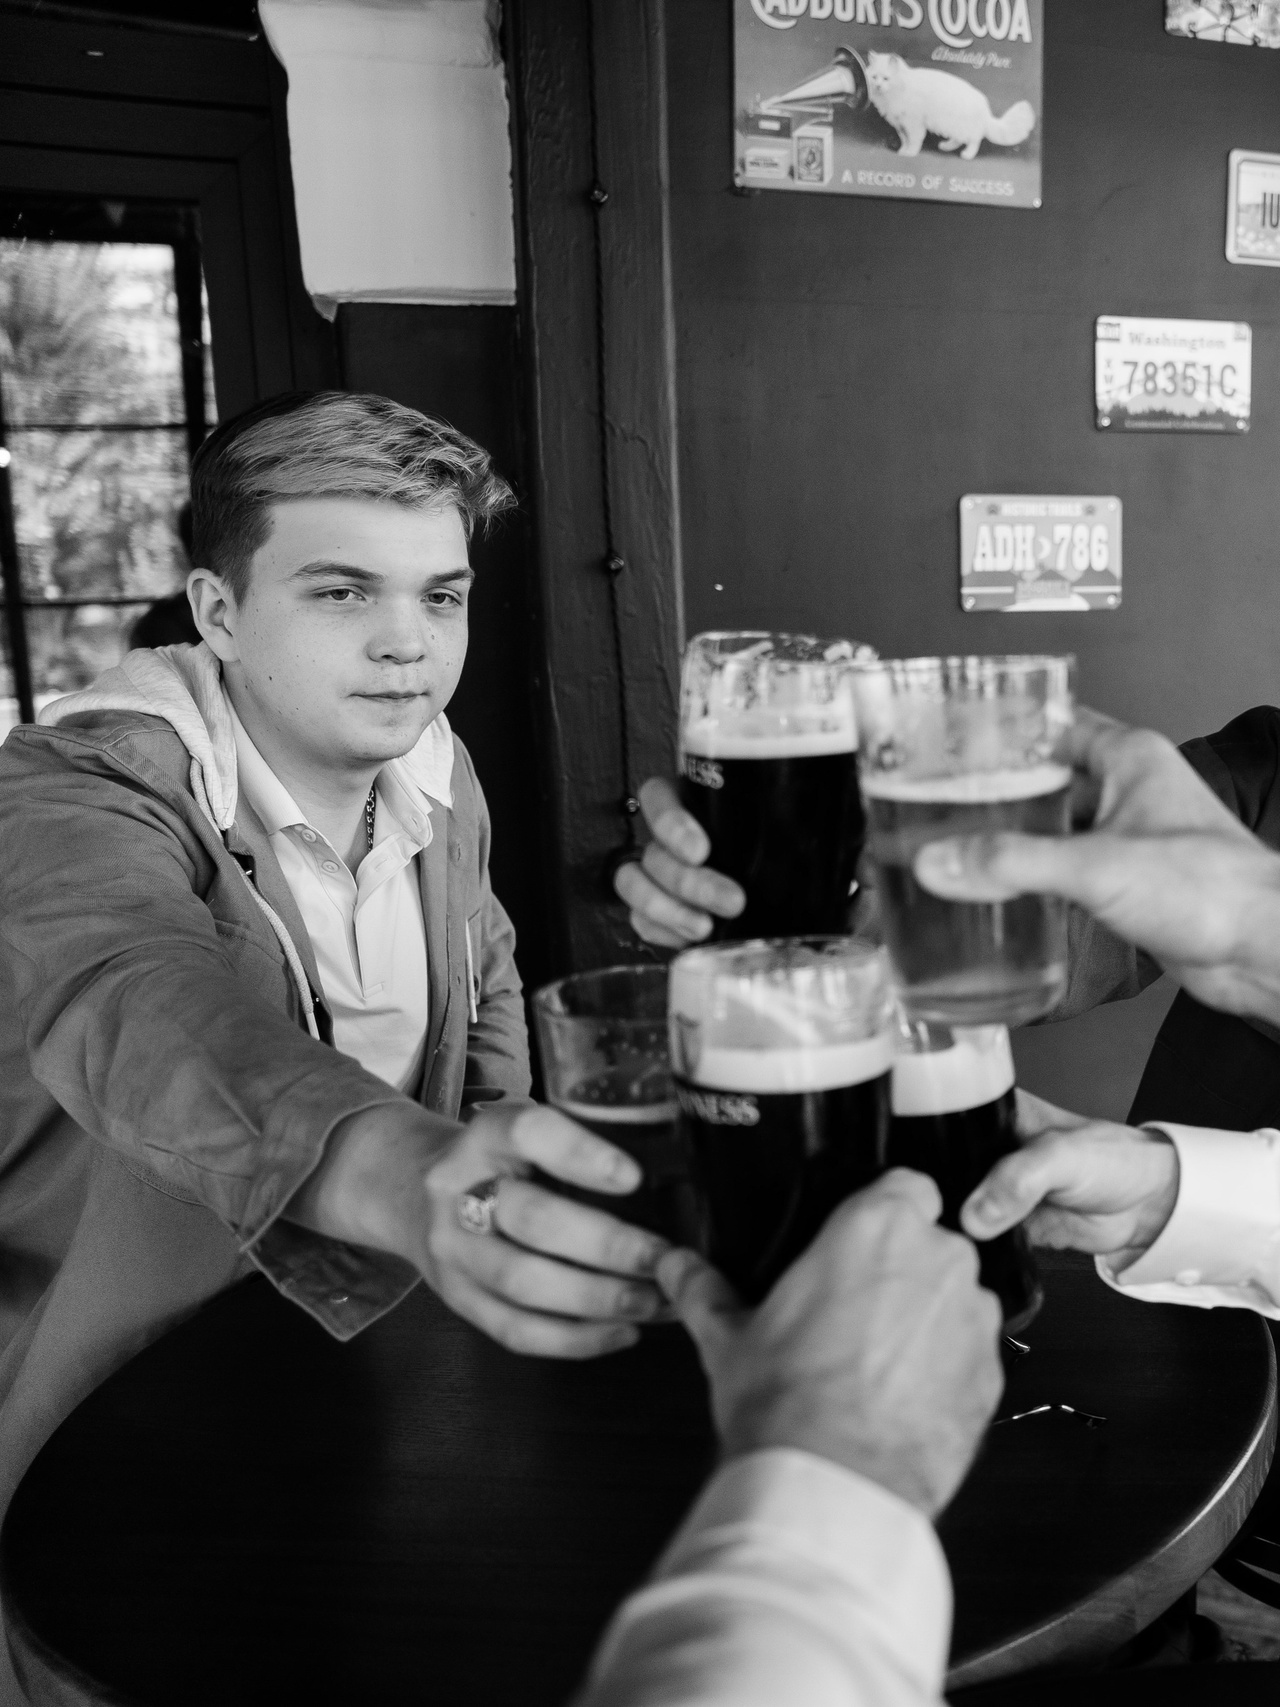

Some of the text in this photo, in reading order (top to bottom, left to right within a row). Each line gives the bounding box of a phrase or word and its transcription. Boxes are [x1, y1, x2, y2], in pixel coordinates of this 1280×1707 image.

[927, 0, 1032, 48] COCOA
[841, 169, 1015, 197] A RECORD OF SUCCESS
[1127, 331, 1227, 352] Washington
[1122, 360, 1237, 398] 78351C
[973, 522, 1110, 572] ADH 786
